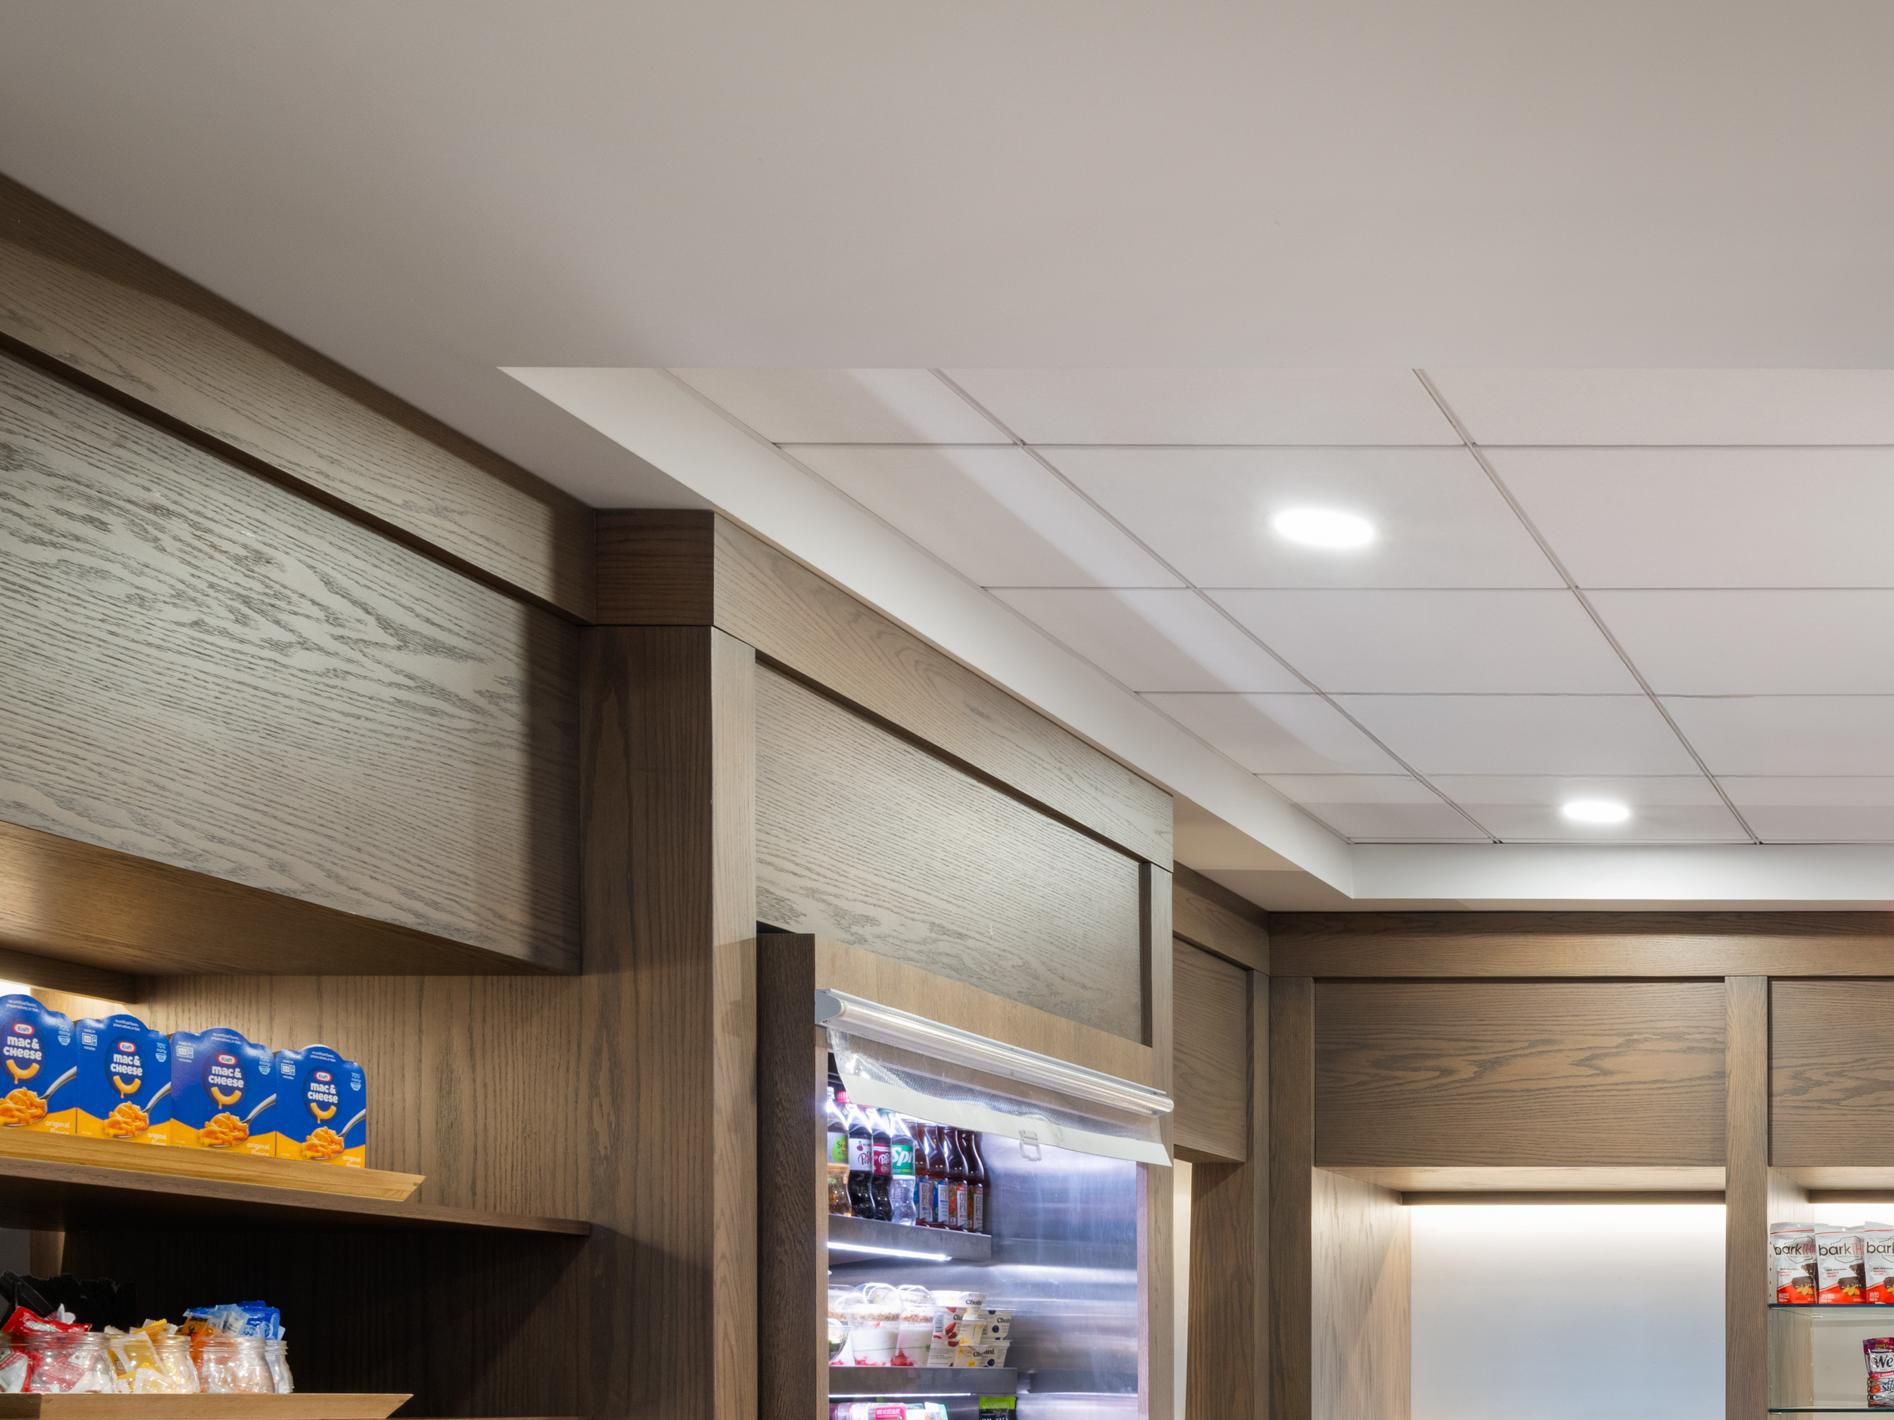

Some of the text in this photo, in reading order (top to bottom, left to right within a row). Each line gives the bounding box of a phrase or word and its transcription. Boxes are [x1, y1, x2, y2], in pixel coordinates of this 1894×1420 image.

[7, 1036, 40, 1049] mac &
[113, 1054, 141, 1066] mac &
[212, 1066, 242, 1078] mac &
[310, 1082, 336, 1094] mac &
